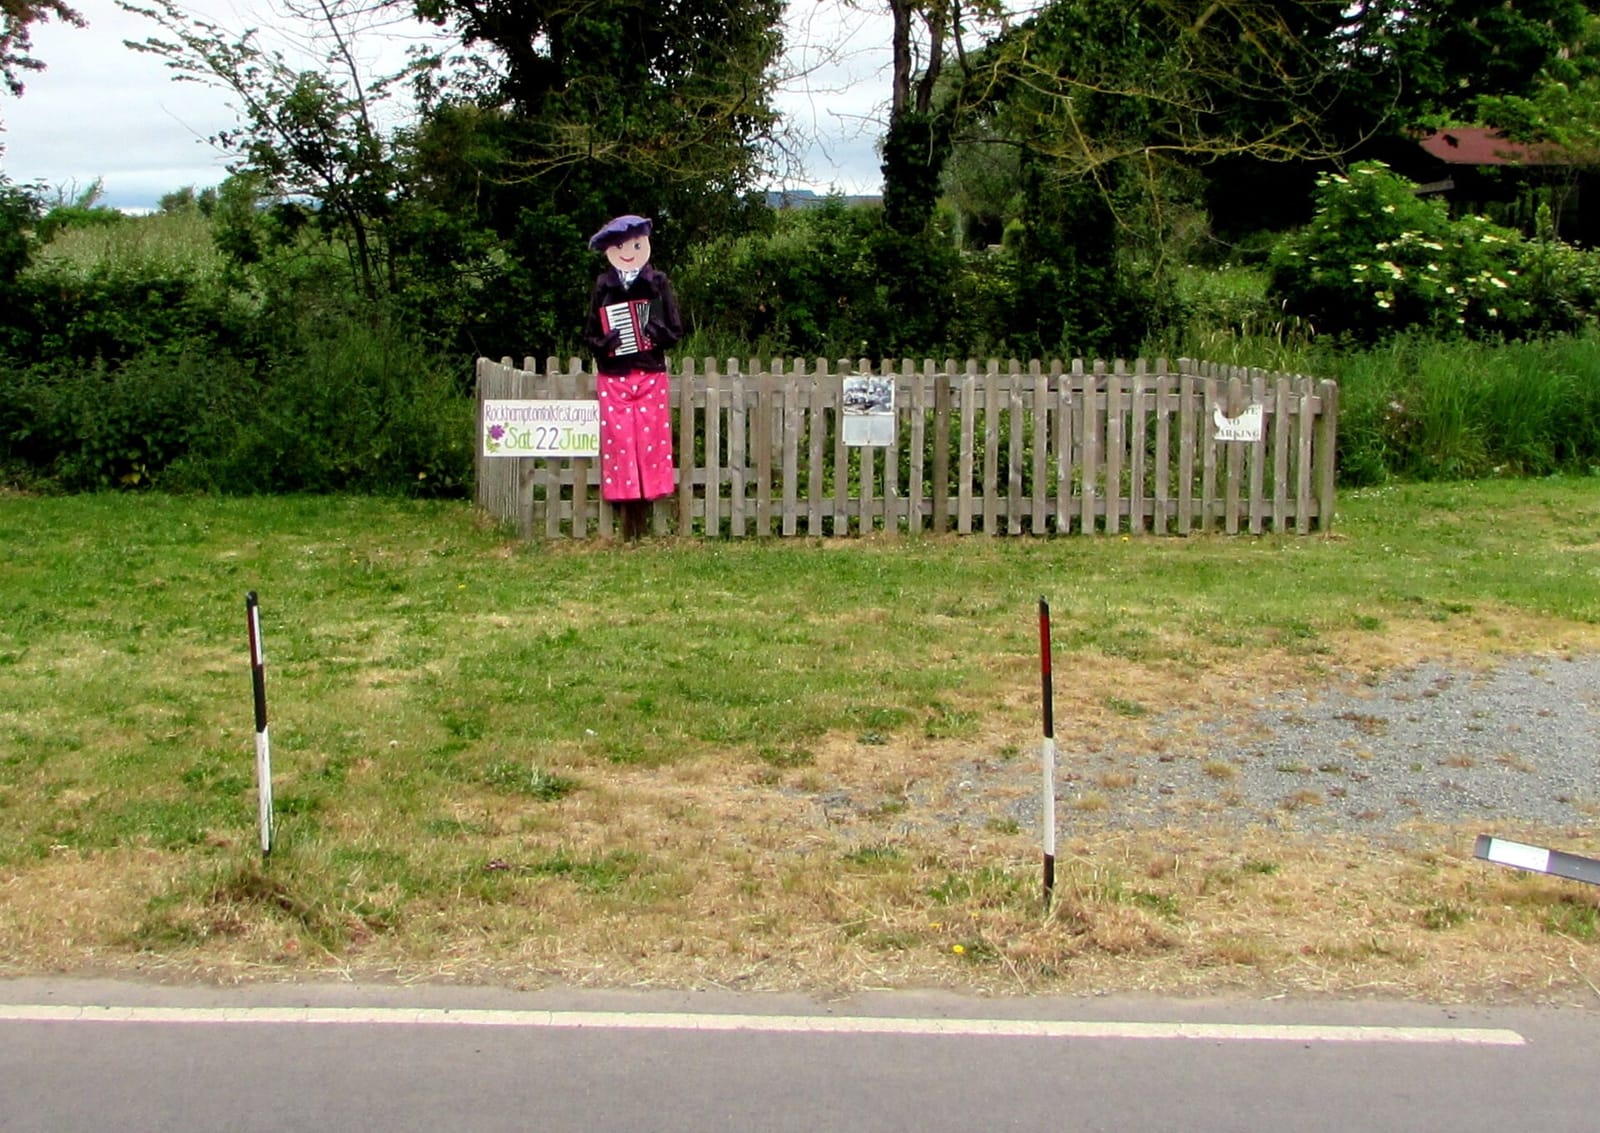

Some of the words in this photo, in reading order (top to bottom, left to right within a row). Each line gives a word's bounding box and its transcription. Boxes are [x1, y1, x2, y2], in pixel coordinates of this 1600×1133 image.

[505, 427, 534, 449] Sat
[536, 427, 559, 450] 22
[559, 428, 598, 450] June
[1217, 429, 1260, 438] ARKING
